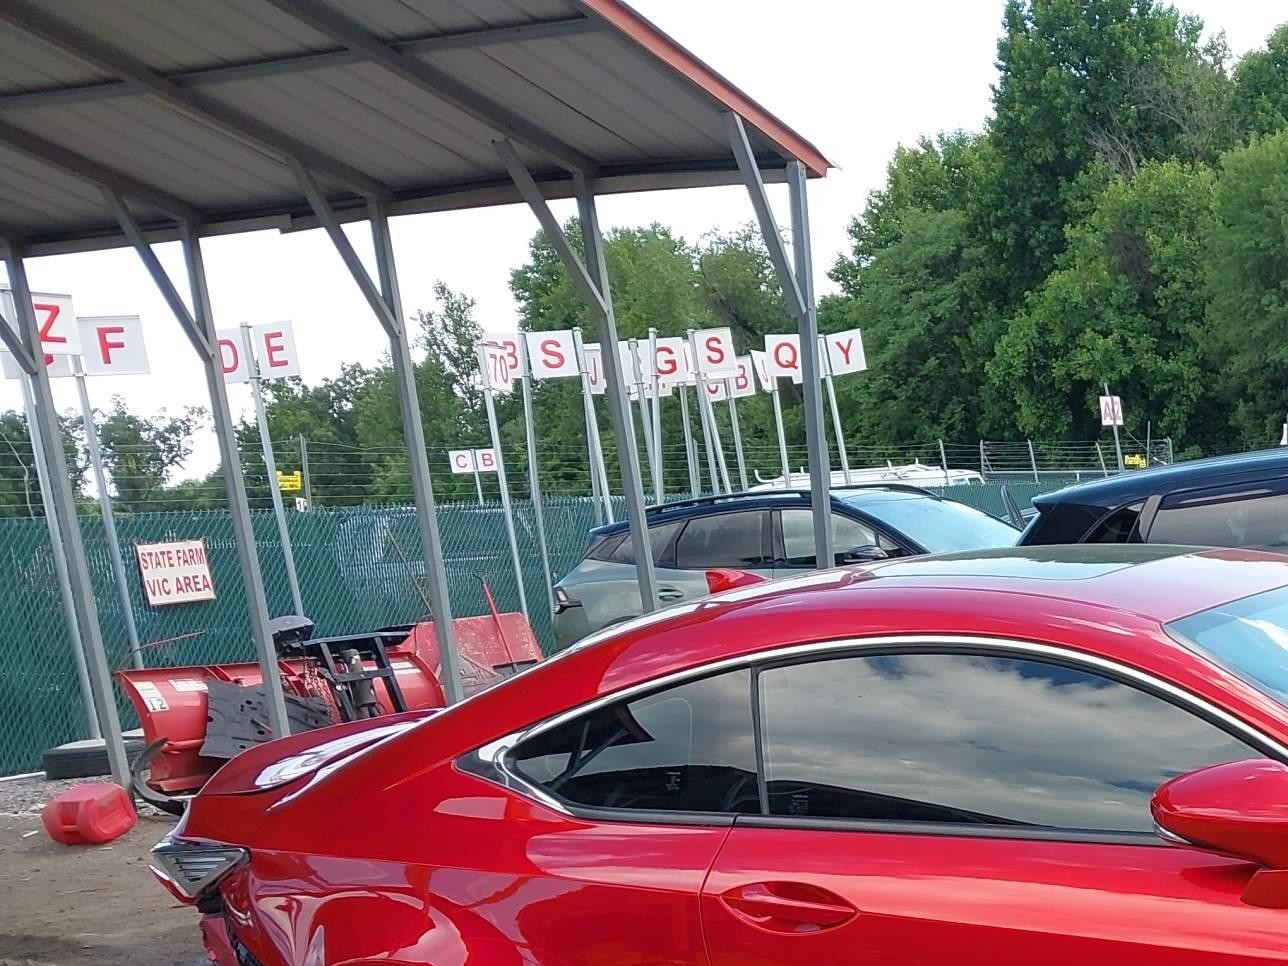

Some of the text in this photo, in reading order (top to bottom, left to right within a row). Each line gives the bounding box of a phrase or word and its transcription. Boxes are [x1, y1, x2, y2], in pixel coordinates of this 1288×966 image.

[33, 303, 67, 343] Z
[96, 326, 125, 365] F
[216, 339, 239, 374] D
[264, 331, 289, 368] E
[540, 339, 565, 369] S
[705, 336, 725, 364] S
[773, 342, 798, 370] Q
[834, 338, 853, 365] Y
[655, 346, 678, 375] G
[455, 454, 468, 469] C
[481, 453, 494, 467] B
[140, 547, 205, 570] STATE FARM
[146, 574, 211, 597] VIC AREA
